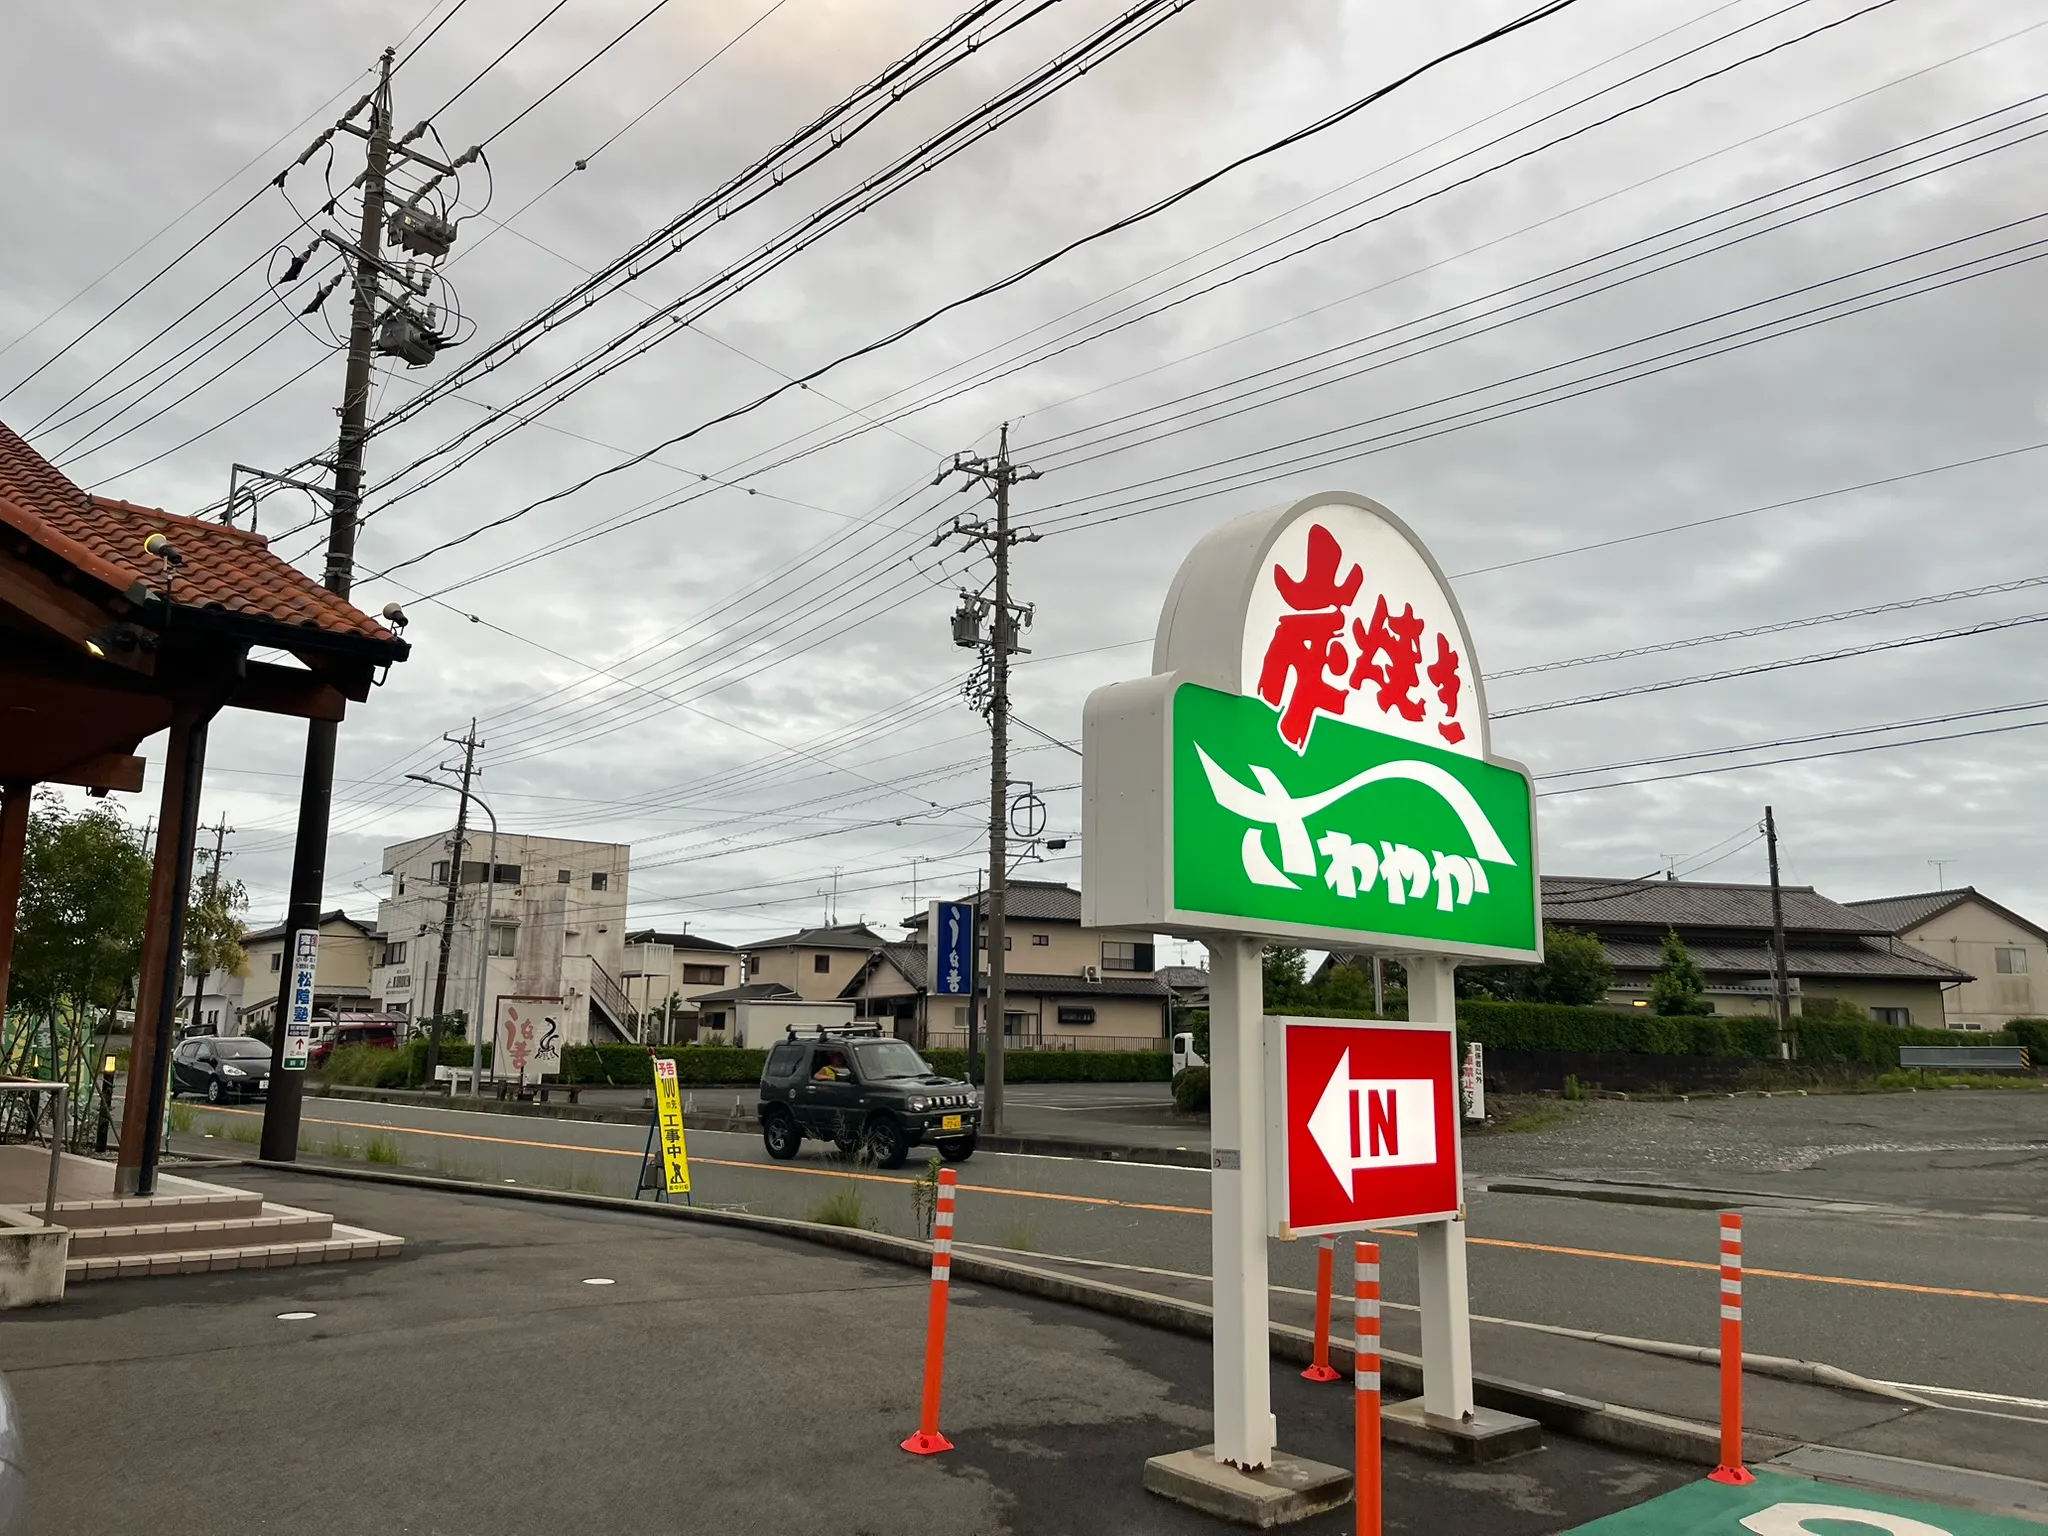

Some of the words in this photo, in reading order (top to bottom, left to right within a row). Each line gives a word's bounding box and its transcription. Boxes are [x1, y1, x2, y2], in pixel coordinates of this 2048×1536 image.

[1257, 523, 1465, 750] 炭焼き
[1193, 740, 1517, 912] さわやか
[658, 1062, 675, 1077] 予告
[661, 1077, 676, 1098] 100
[663, 1114, 681, 1159] 工事中
[1349, 1089, 1399, 1158] IN
